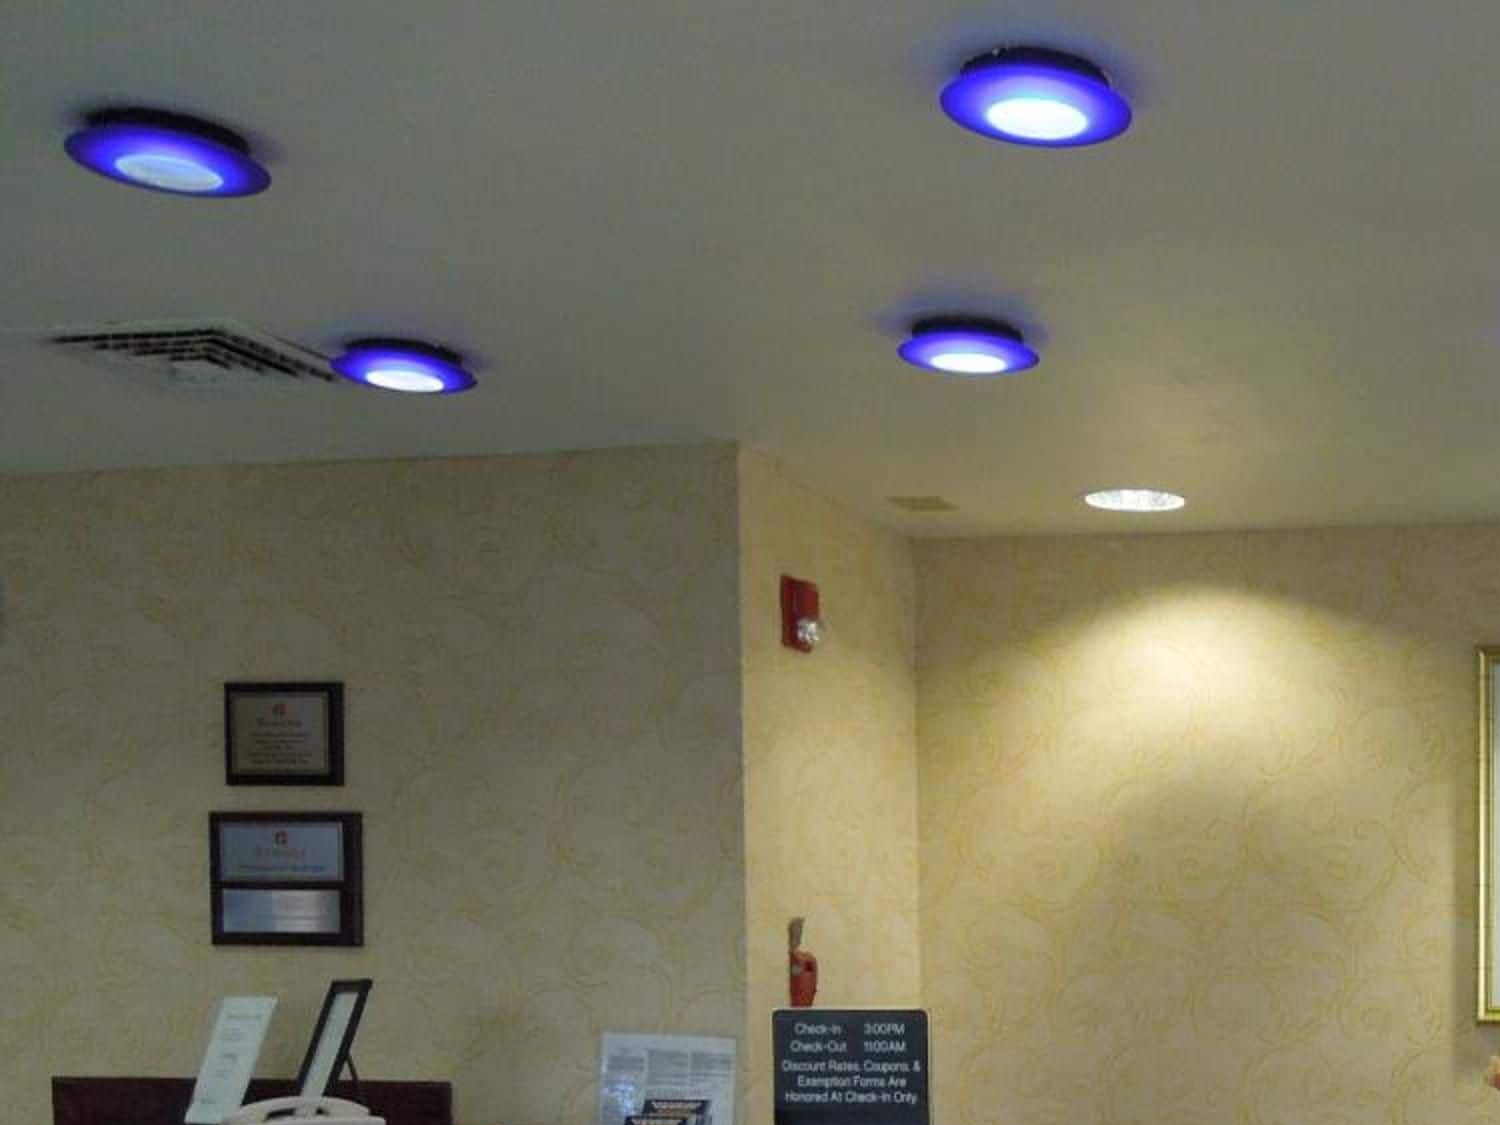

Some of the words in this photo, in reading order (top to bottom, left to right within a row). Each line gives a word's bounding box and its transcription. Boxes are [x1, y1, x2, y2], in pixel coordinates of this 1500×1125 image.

[782, 1060, 826, 1072] Discount
[913, 1060, 921, 1072] &
[797, 1075, 851, 1088] Exemption
[852, 1075, 885, 1087] Forms
[887, 1075, 907, 1087] Are
[785, 1091, 829, 1102] Honored
[831, 1091, 842, 1102] At
[893, 1091, 918, 1105] Only
